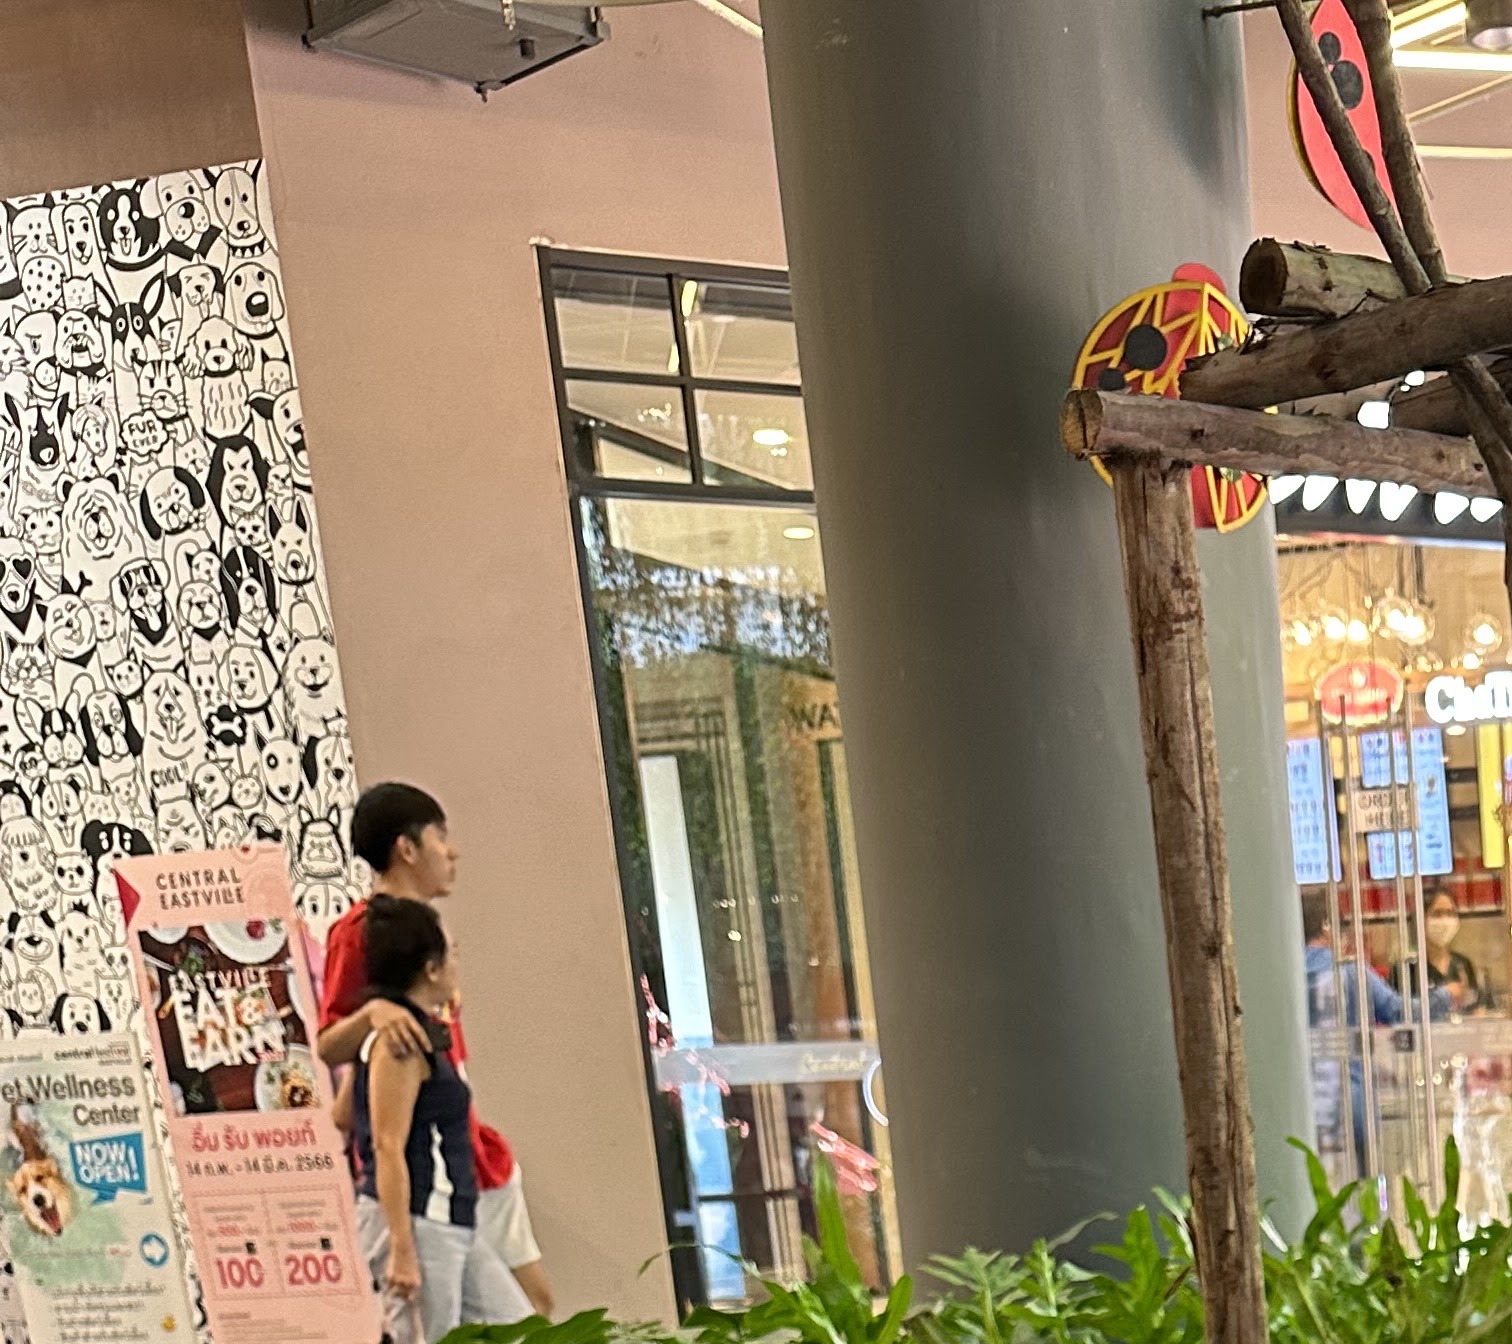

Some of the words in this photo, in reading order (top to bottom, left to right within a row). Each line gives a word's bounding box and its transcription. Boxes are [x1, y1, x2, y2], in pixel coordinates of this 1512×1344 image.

[128, 419, 157, 436] FUR
[156, 867, 241, 890] CENTRAL
[159, 887, 245, 910] EASTVILLE
[168, 967, 272, 992] EASTVILLE
[179, 1022, 286, 1072] EARN
[27, 1073, 136, 1100] Wellness
[73, 1103, 141, 1127] Center
[75, 1141, 126, 1166] NOW
[294, 1153, 335, 1172] 2566
[215, 1257, 265, 1289] 100
[284, 1254, 343, 1286] 200
